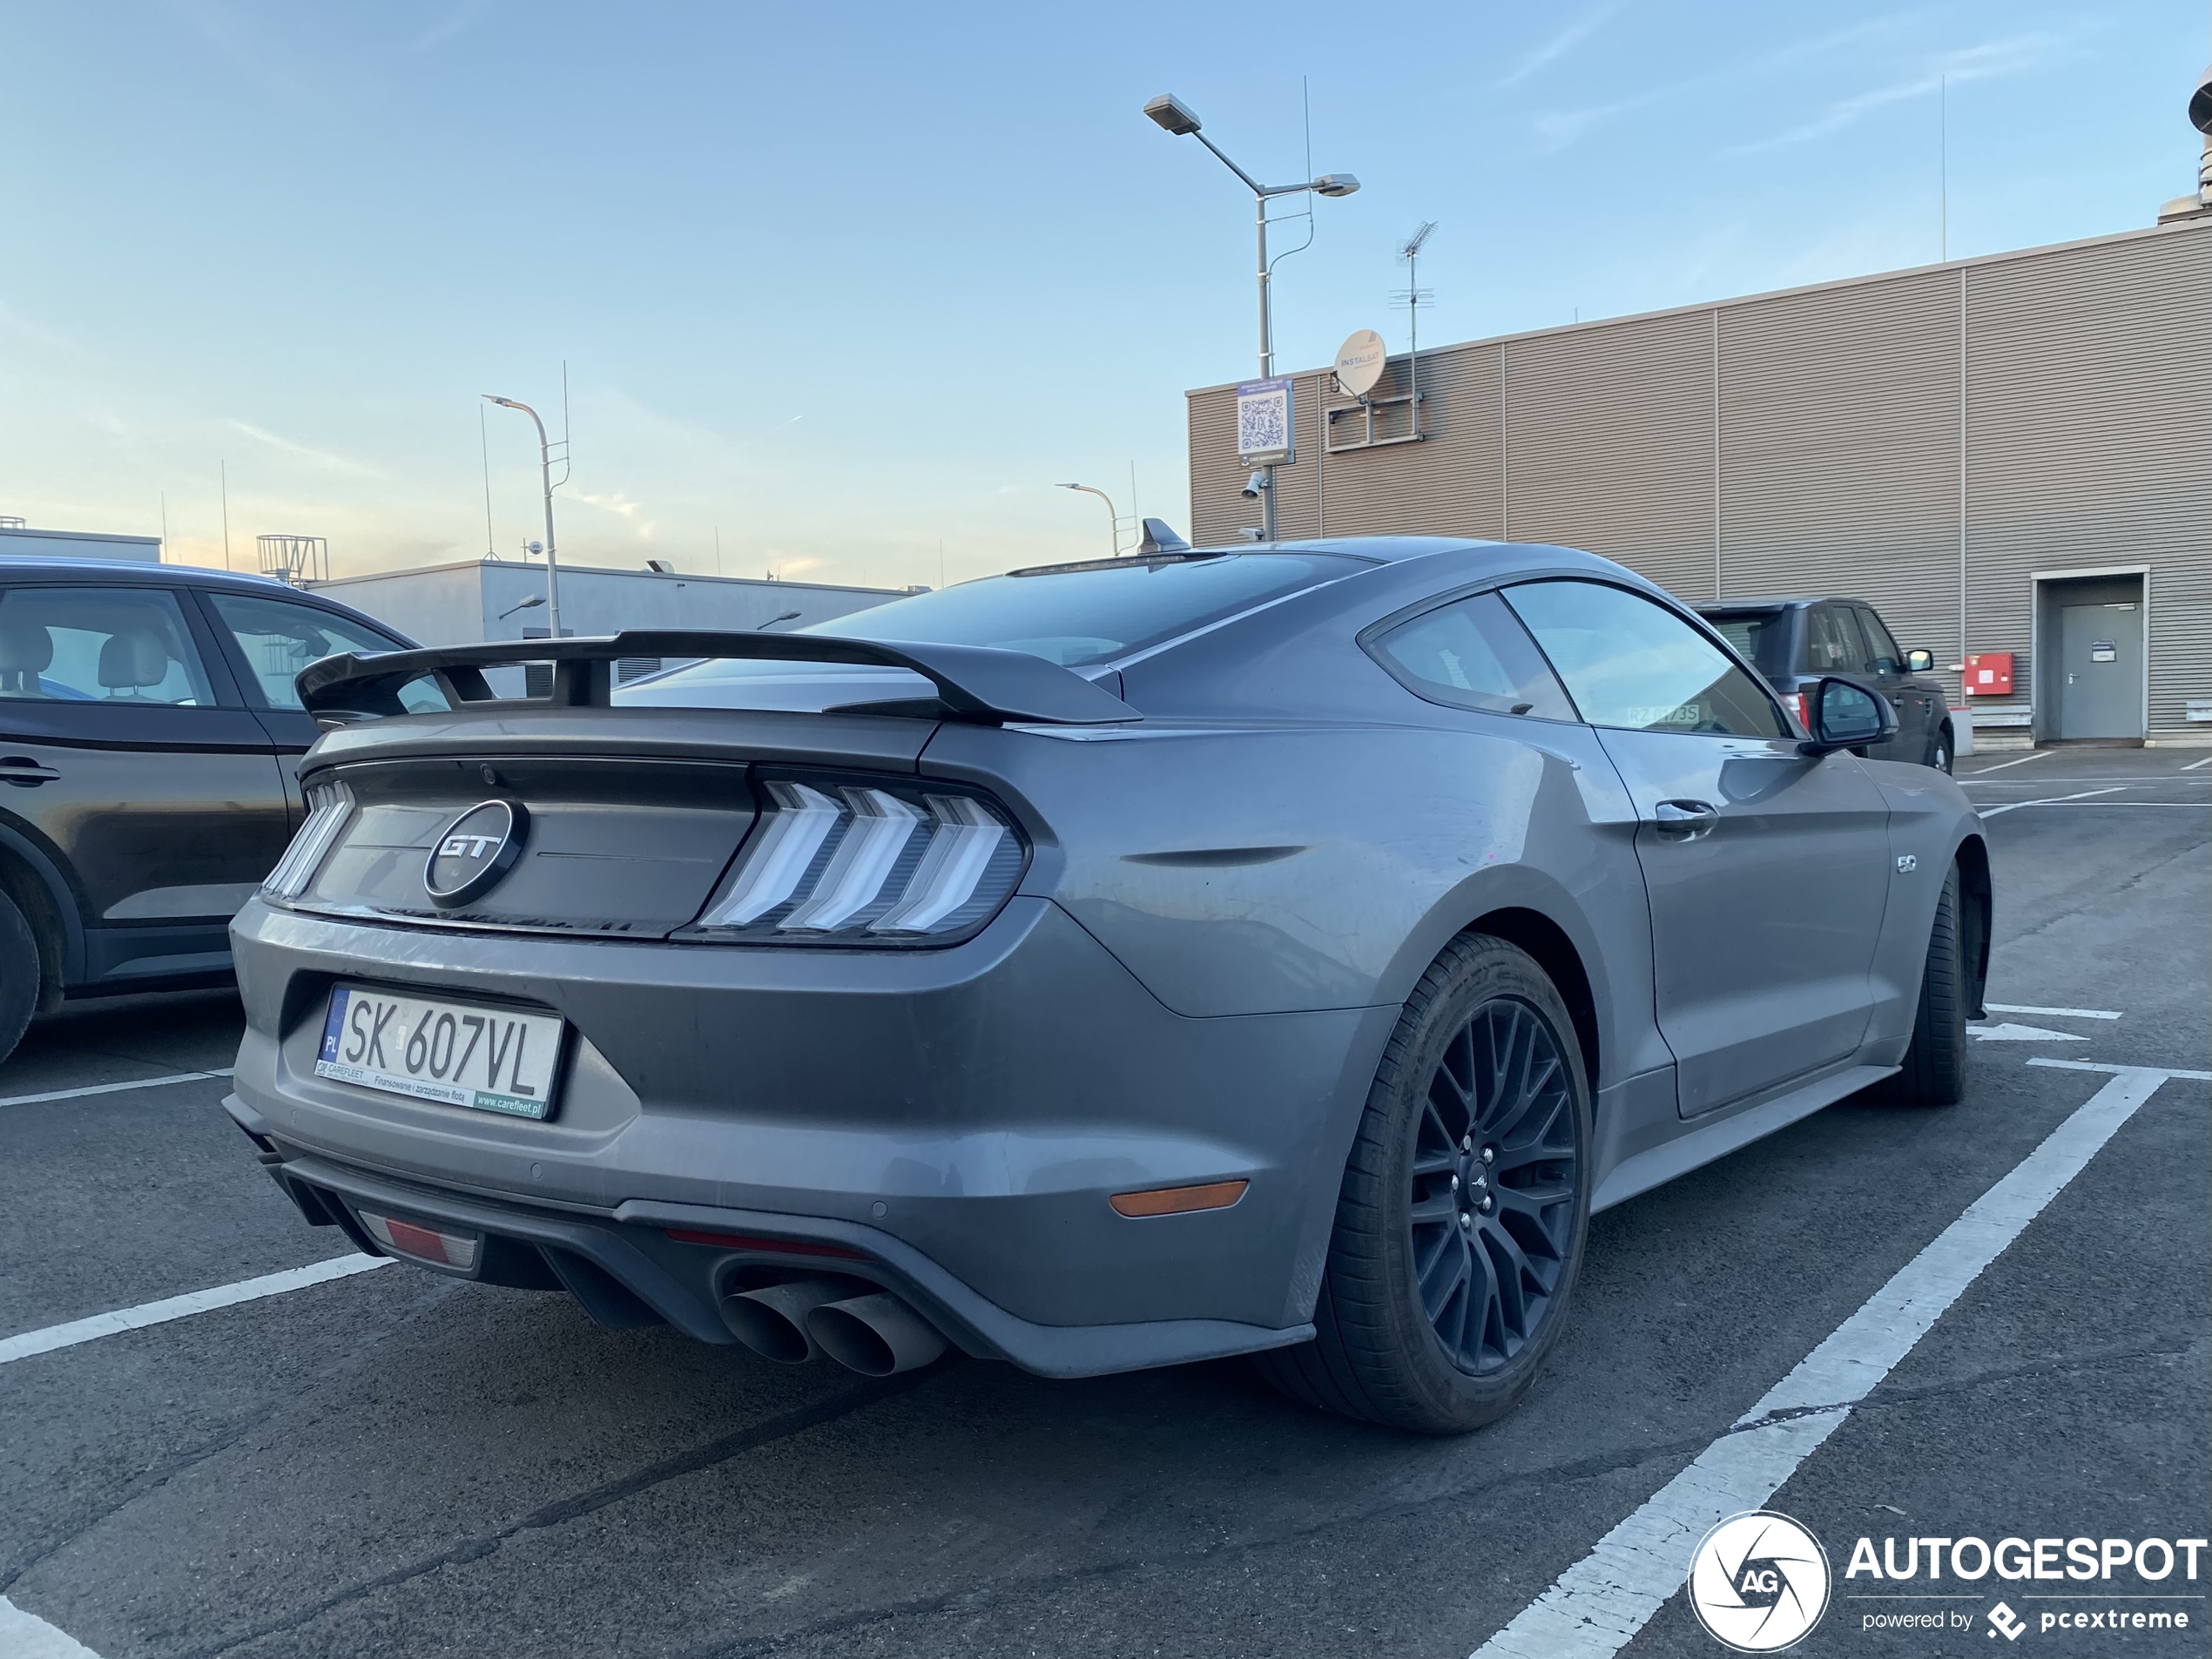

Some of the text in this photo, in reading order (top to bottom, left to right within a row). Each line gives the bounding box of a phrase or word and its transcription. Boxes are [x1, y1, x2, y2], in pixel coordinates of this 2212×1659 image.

[1341, 352, 1379, 366] INSTALSAT
[438, 834, 502, 859] GT
[325, 1035, 337, 1053] PL
[346, 1000, 535, 1096] SK 607VL
[328, 1063, 364, 1080] CAREFLEET
[374, 1076, 411, 1092] Finansowanie
[415, 1085, 449, 1099] zarządzanie
[451, 1090, 465, 1103] flotą
[477, 1096, 541, 1116] www.carefleet.pl
